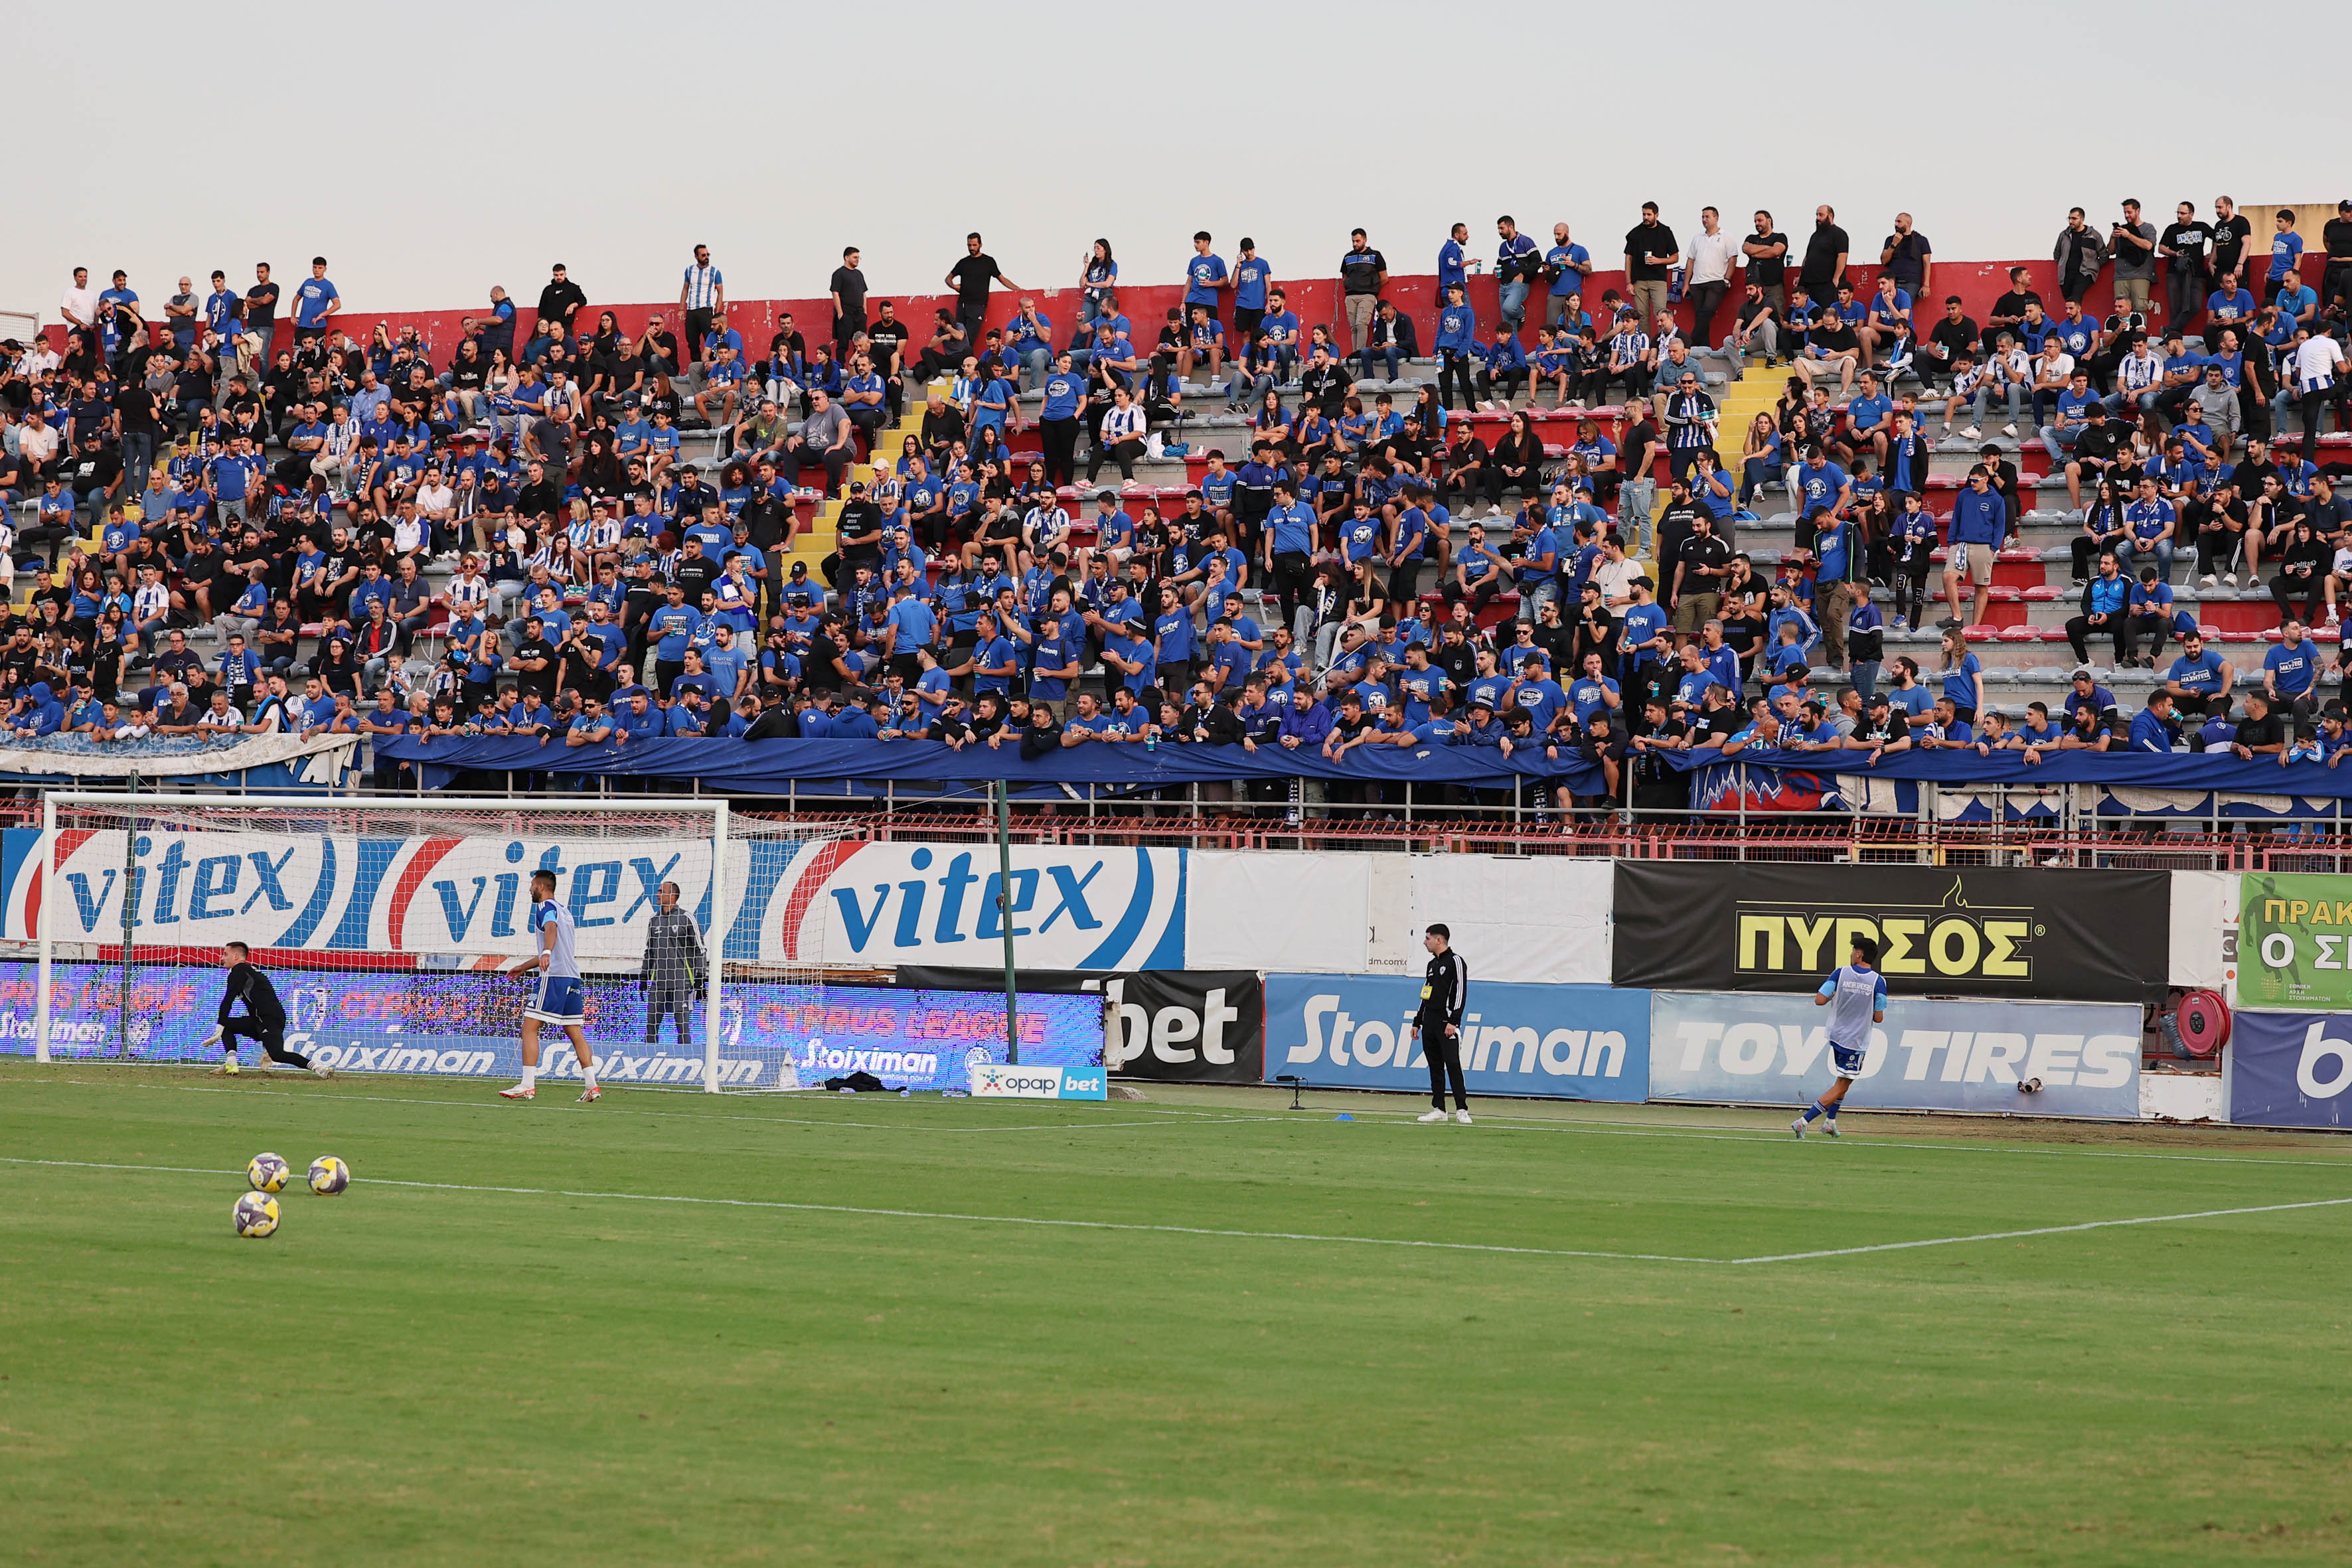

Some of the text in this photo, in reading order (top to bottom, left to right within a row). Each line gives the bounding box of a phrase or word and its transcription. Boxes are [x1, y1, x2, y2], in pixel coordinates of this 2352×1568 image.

[66, 836, 294, 933] vitex
[831, 848, 1104, 953] vitex
[1739, 915, 2028, 977] ΠΥΡΣΟΣ
[2313, 934, 2352, 970] Σ
[756, 1003, 1048, 1043] CYPRUS LEAGUE
[1083, 979, 1238, 1065] bet
[1287, 994, 1626, 1077] Stoiiman
[274, 1033, 495, 1075] Stoiximan
[802, 1038, 937, 1074] Stoiximan
[1006, 1075, 1100, 1094] opap bet
[1676, 1022, 2141, 1089] TOYO TIRES
